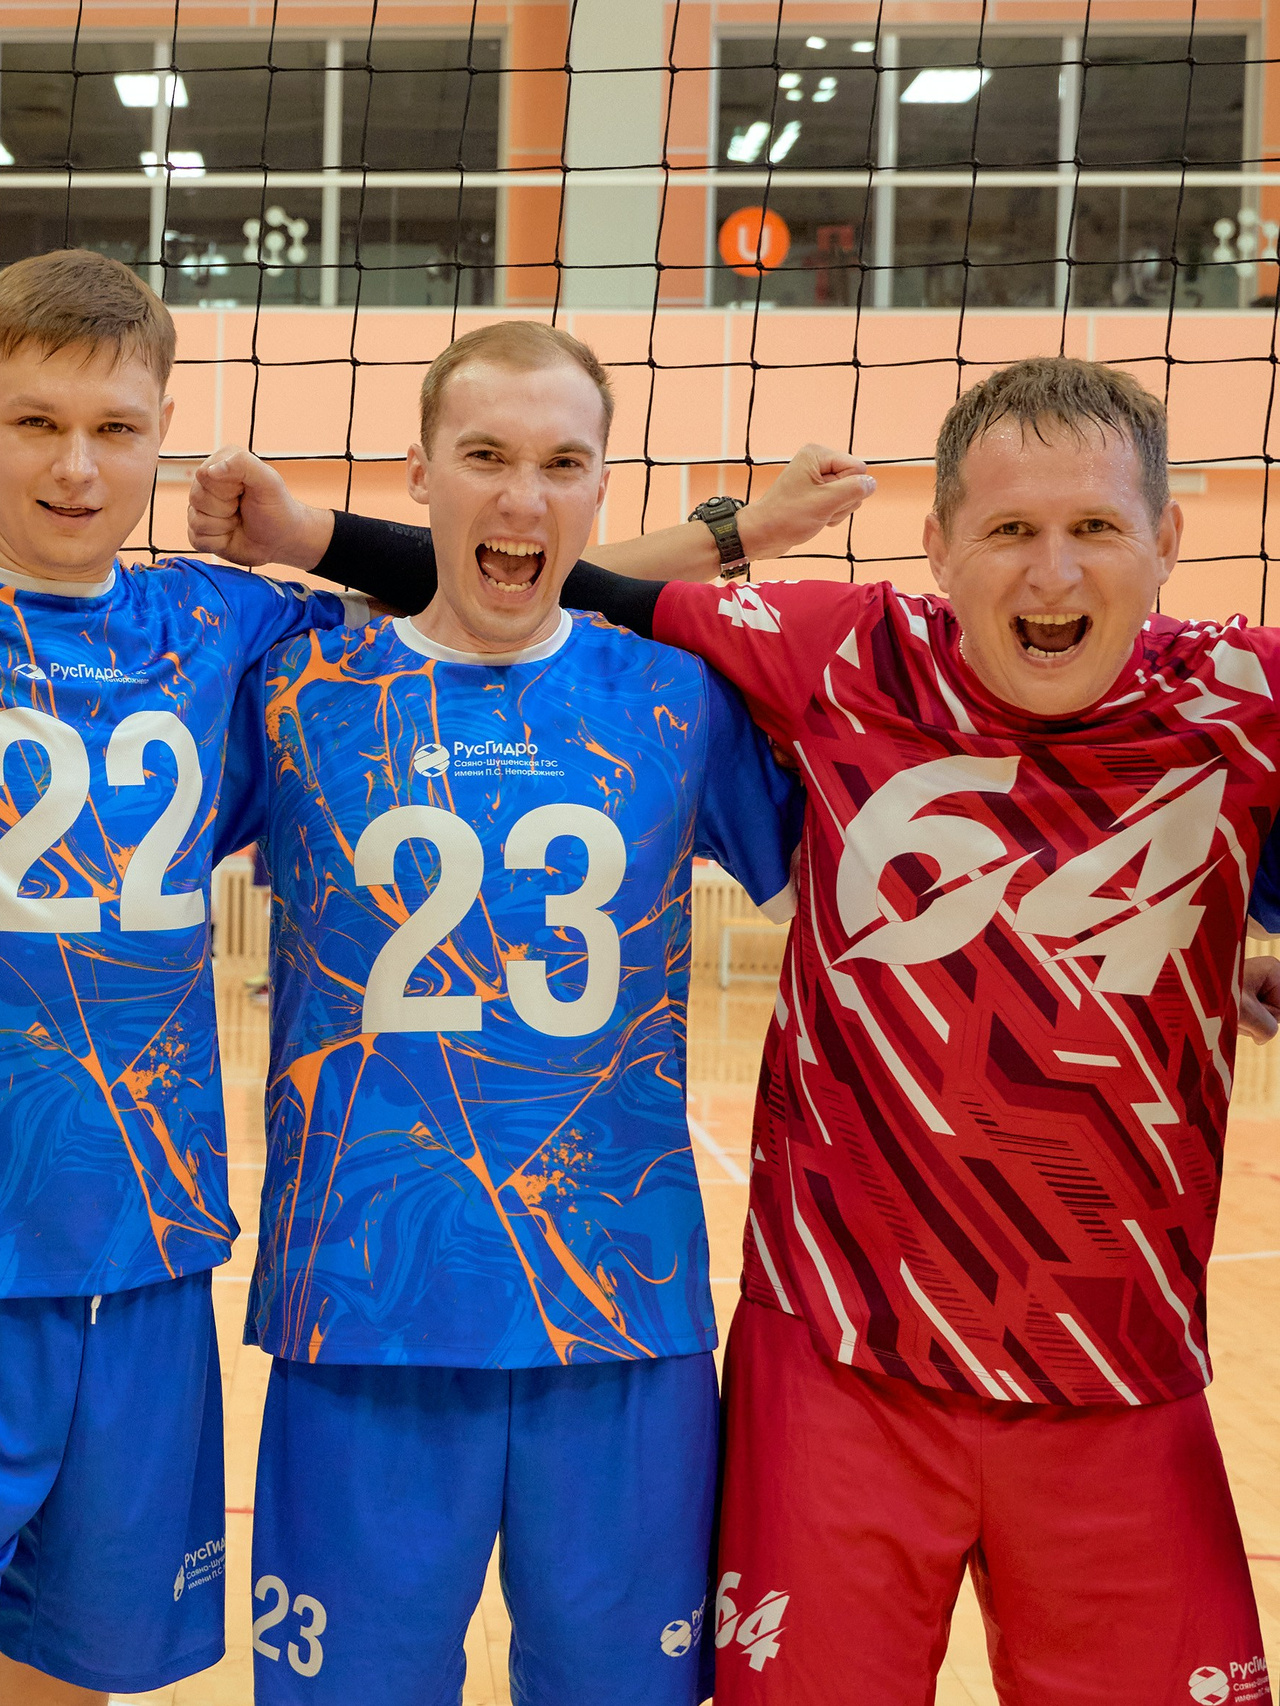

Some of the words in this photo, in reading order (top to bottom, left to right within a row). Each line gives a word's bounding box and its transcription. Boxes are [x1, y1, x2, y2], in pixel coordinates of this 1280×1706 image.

[737, 225, 771, 262] U
[50, 662, 123, 681] РусГидро
[453, 740, 538, 759] РусГидро
[453, 758, 540, 768] Саяно-Шушенская
[540, 759, 559, 768] ГЭС
[454, 769, 484, 777] имени
[485, 768, 503, 776] П.С.
[505, 767, 565, 777] Непорожнего
[826, 754, 1225, 997] 64
[353, 803, 627, 1038] 23
[252, 1574, 327, 1678] 23
[715, 1571, 790, 1672] 64
